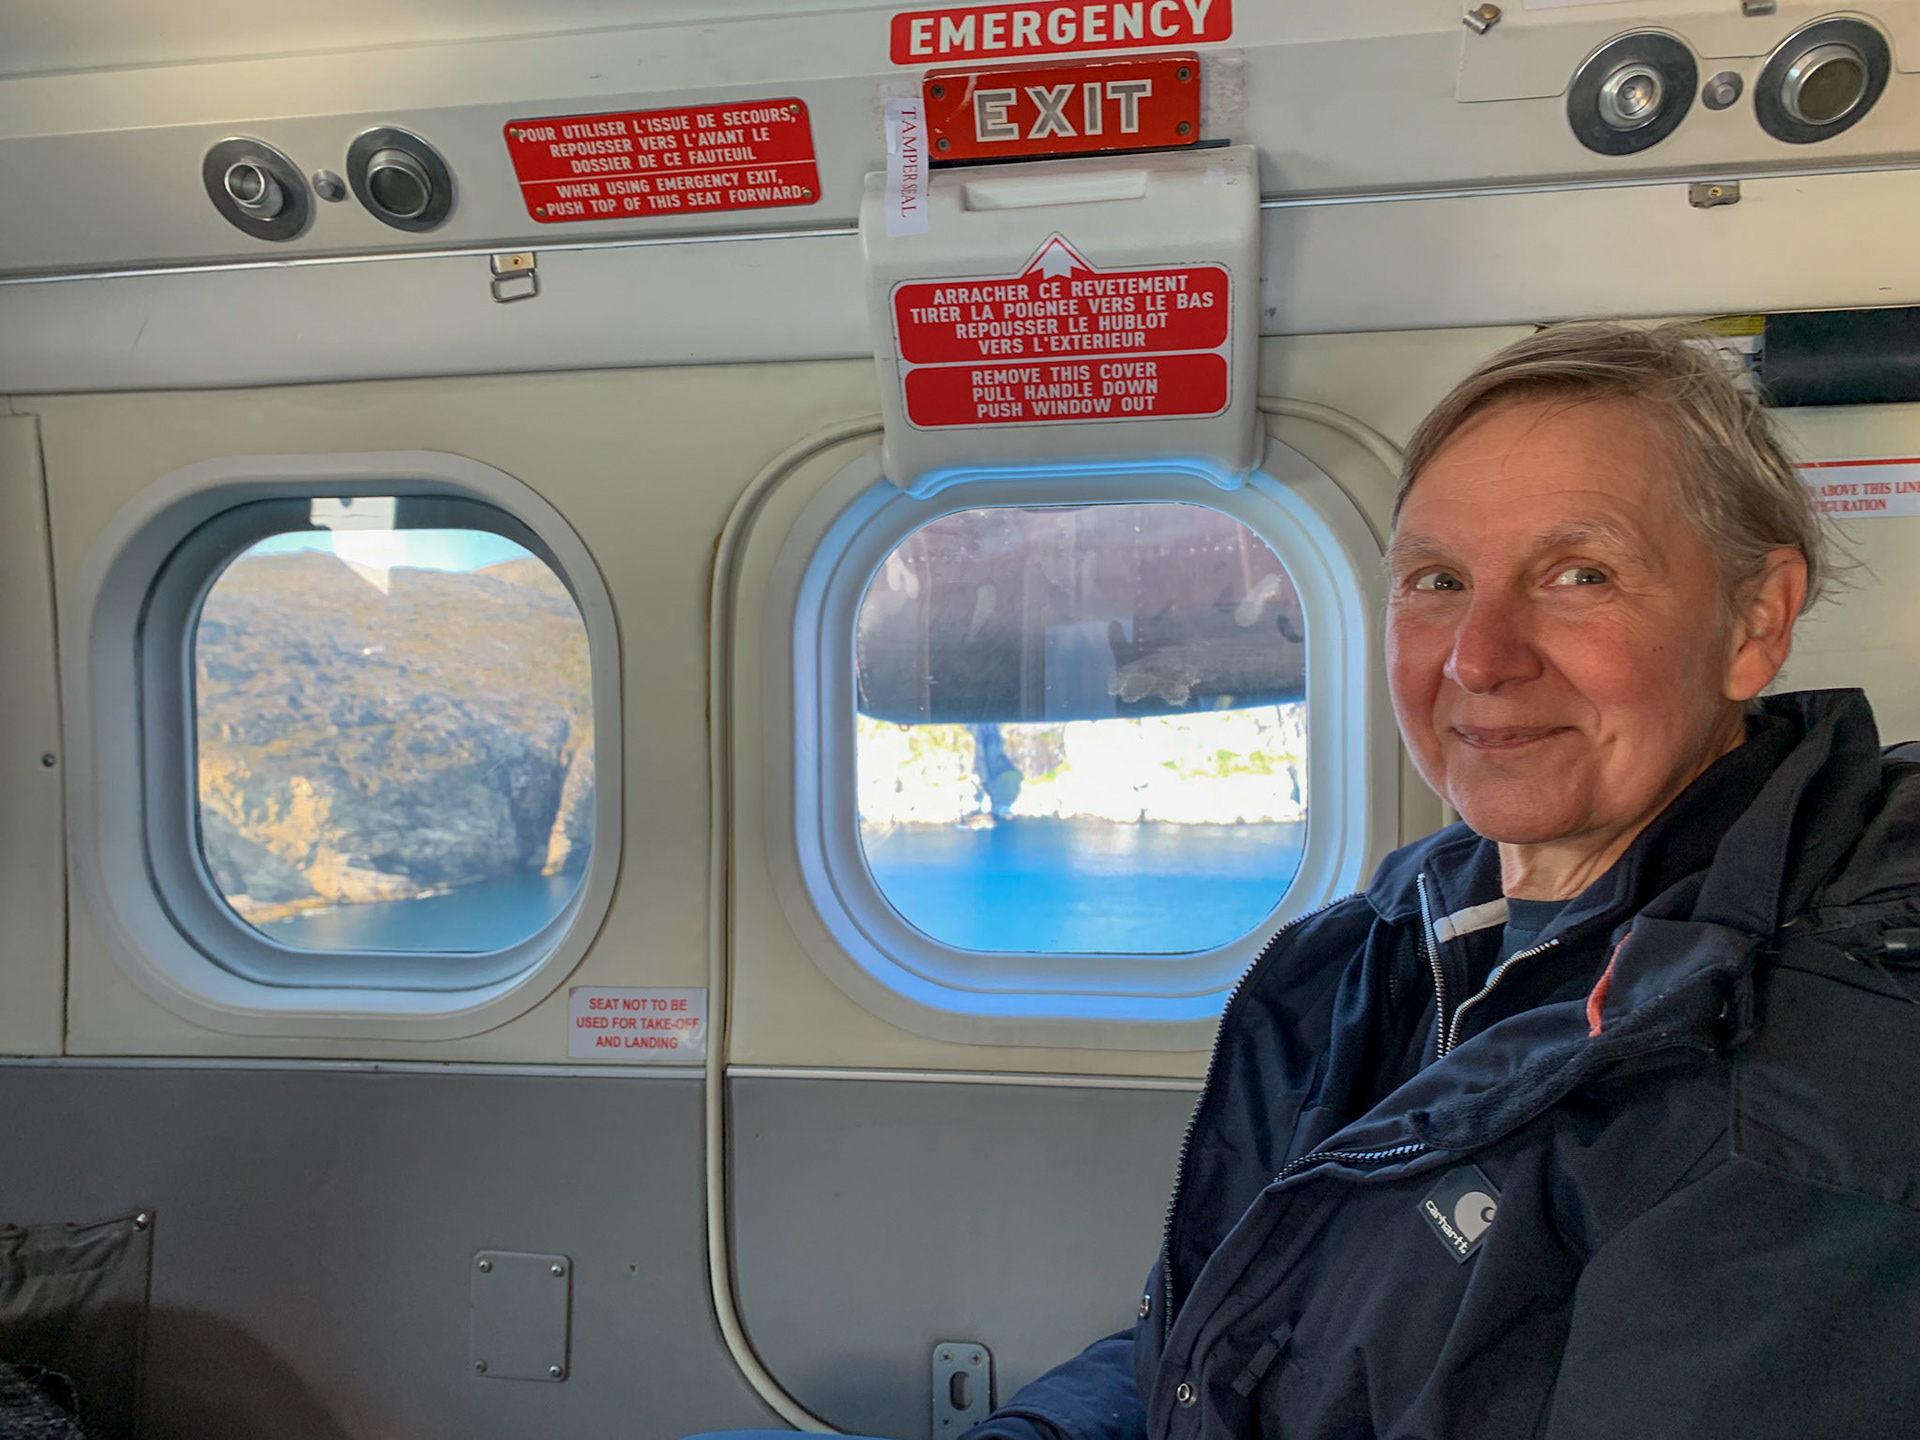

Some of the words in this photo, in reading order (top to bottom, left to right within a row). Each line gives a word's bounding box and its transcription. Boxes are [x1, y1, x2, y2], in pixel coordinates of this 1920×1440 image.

[909, 0, 1212, 55] EMERGENCY
[973, 79, 1152, 142] EXIT
[518, 127, 557, 143] POUR
[562, 121, 627, 139] UTILISER
[632, 115, 690, 134] L'ISSUE
[696, 114, 716, 128] DE
[723, 107, 796, 126] SECOURS,
[549, 138, 633, 158] REPOUSSER
[638, 135, 677, 151] VERS
[683, 129, 744, 147] L'AVANT
[752, 127, 770, 142] LE
[901, 107, 918, 182] TAMPER
[570, 156, 632, 174] DOSSIER
[637, 154, 657, 168] DE
[663, 152, 682, 166] CE
[688, 146, 757, 164] FAUTEUIL
[556, 183, 600, 198] WHEN
[605, 179, 650, 195] USING
[655, 172, 739, 191] EMERGENCY
[746, 169, 783, 185] EXIT,
[546, 201, 585, 216] PUSH
[589, 198, 617, 213] TOP
[623, 197, 641, 210] OF
[647, 194, 681, 209] THIS
[687, 191, 721, 206] SEAT
[901, 184, 918, 218] SEAL
[933, 284, 1029, 305] ARRACHER
[1039, 282, 1061, 298] CE
[1071, 275, 1188, 297] REVETEMENT
[910, 306, 961, 324] TIRER
[971, 305, 994, 320] LA
[1003, 300, 1078, 319] POIGNEE
[1089, 296, 1135, 314] VERS
[1145, 295, 1166, 311] LE
[1176, 292, 1214, 309] BAS
[955, 318, 1058, 339] REPOUSSER
[1068, 317, 1088, 333] LE
[1098, 312, 1168, 331] HUBLOT
[978, 338, 1023, 355] VERS
[1033, 331, 1146, 352] L'EXTERIEUR
[971, 367, 1040, 386] REMOVE
[1050, 365, 1090, 382] THIS
[1100, 362, 1157, 379] COVER
[972, 386, 1015, 402] PULL
[1024, 382, 1092, 400] HANDLE
[1103, 379, 1158, 396] DOWN
[977, 402, 1023, 418] PUSH
[1032, 398, 1111, 416] WINDOW
[1121, 396, 1155, 411] OUT
[1820, 484, 1859, 497] ABOVE
[1863, 482, 1891, 495] THIS
[589, 998, 619, 1010] SEAT
[622, 999, 647, 1011] NOT
[651, 999, 667, 1011] TO
[671, 999, 687, 1011] BE
[576, 1016, 609, 1028] USED
[612, 1017, 637, 1029] FOR
[640, 1018, 700, 1030] TAKE-OFF
[595, 1036, 621, 1047] AND
[625, 1037, 678, 1049] LANDING
